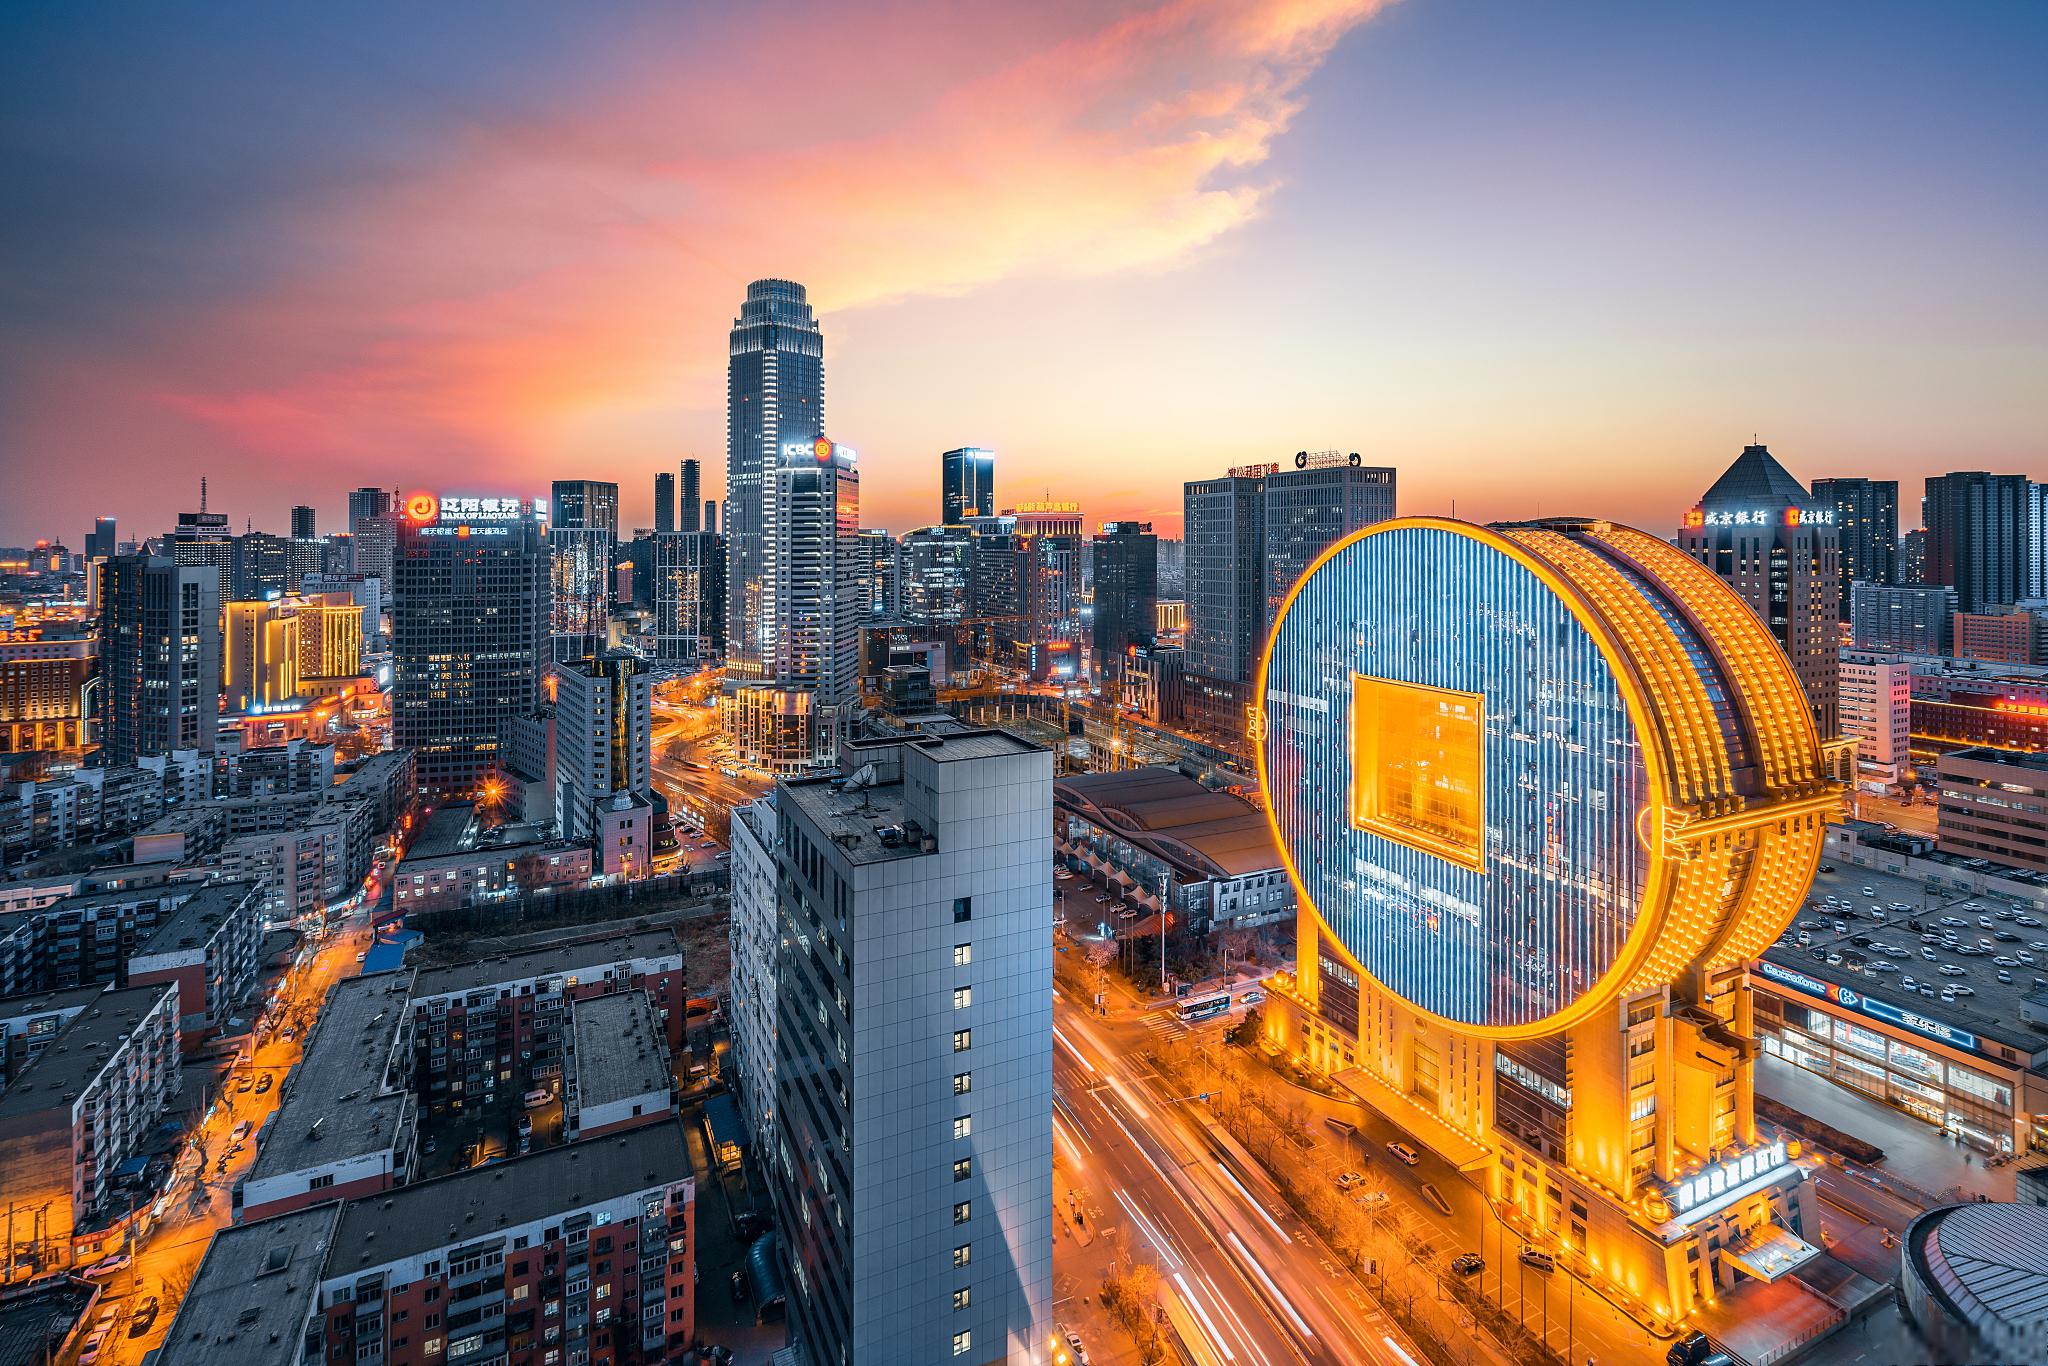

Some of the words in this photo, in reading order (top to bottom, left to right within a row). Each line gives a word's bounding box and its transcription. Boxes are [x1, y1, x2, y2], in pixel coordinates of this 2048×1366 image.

[783, 444, 814, 456] ICBC
[440, 498, 520, 512] 辽阳银行
[1763, 963, 1826, 993] Carrefour
